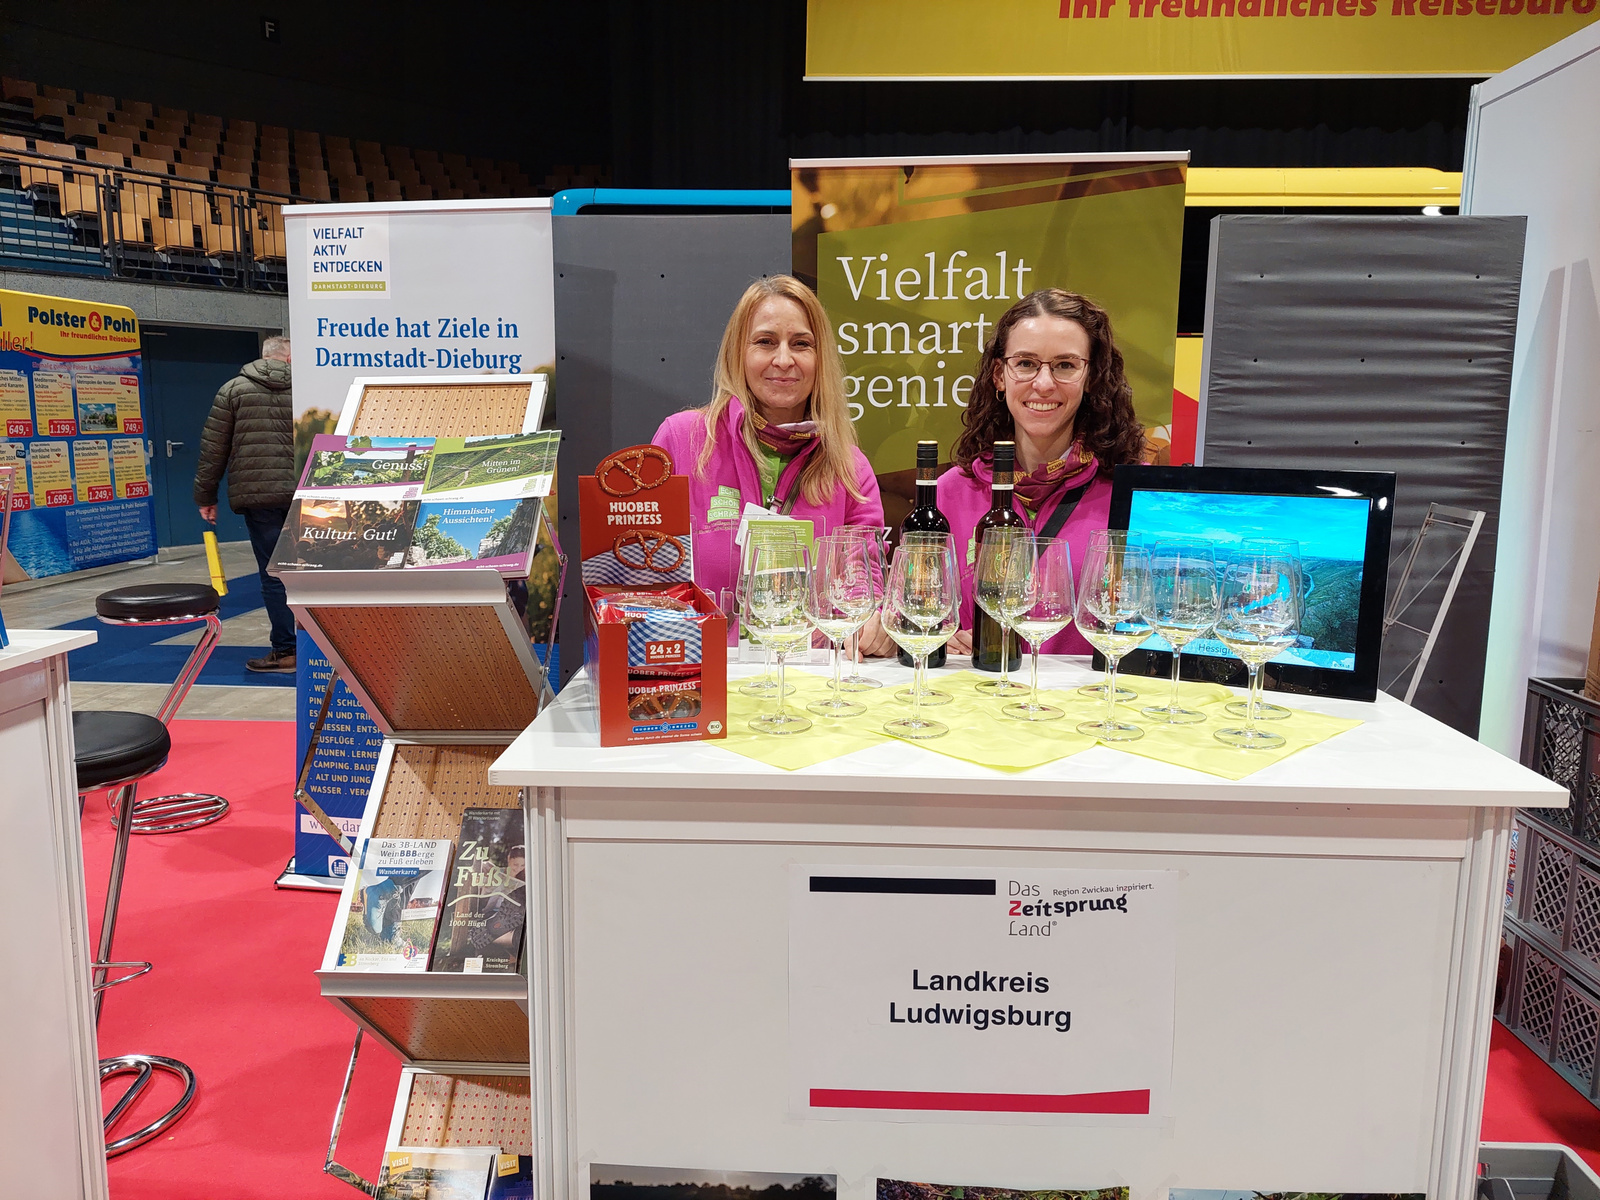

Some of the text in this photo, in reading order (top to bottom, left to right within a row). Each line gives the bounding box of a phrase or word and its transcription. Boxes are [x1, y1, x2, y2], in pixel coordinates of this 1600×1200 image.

[265, 21, 275, 38] F
[313, 227, 365, 240] VIELFALT
[313, 244, 347, 256] AKTIV
[313, 261, 383, 273] ENTDECKEN
[836, 250, 1032, 301] Vielfalt
[28, 306, 136, 333] Polster & Pohl
[316, 317, 519, 339] Freude hat Ziele in
[837, 313, 993, 354] smart
[0, 331, 33, 351] ller!
[60, 330, 70, 338] Ihr
[71, 331, 108, 341] freundliches
[315, 347, 522, 374] Darmstadt-Dieburg
[842, 360, 976, 422] genie
[371, 459, 427, 471] Genuss!
[486, 465, 520, 474] Grünen!
[443, 507, 496, 516] Himmlische
[609, 502, 659, 513] HUOBER
[442, 516, 493, 524] Aussichten!
[607, 513, 663, 526] PRINZESS
[302, 527, 398, 541] Kultur. Gut!
[624, 611, 647, 619] HUOB
[649, 644, 664, 655] 24
[674, 643, 681, 654] 2
[1199, 643, 1233, 656] Hessig
[629, 682, 697, 695] UOBER PRINZESS
[337, 699, 362, 707] SCHLO
[309, 710, 371, 721] ESN UND TRI
[309, 722, 351, 732] GIESSEN
[318, 735, 355, 745] USFLÜGE
[315, 748, 346, 757] TAUNEN
[354, 763, 377, 772] BAUE
[316, 773, 371, 784] ALT UND JUNG
[310, 785, 370, 796] WASSER VERA
[381, 841, 437, 849] Das 3B-LAND
[459, 840, 490, 861] Zu
[380, 850, 435, 859] WeinBBBerge
[389, 857, 403, 865] Fuß
[405, 857, 434, 865] erleben
[378, 868, 418, 876] Wanderkarte
[454, 866, 512, 887] Fuß!
[1008, 880, 1041, 897] Das
[1053, 883, 1155, 898] Region Zwickau inzpiriert.
[1008, 893, 1128, 917] Zeitsprung
[457, 911, 473, 919] Land
[468, 920, 487, 928] Hügel
[912, 969, 1050, 993] Landkreis
[889, 1002, 1072, 1033] Ludwigsburg
[391, 1156, 410, 1168] VISIT
[499, 1159, 516, 1170] VISIT
